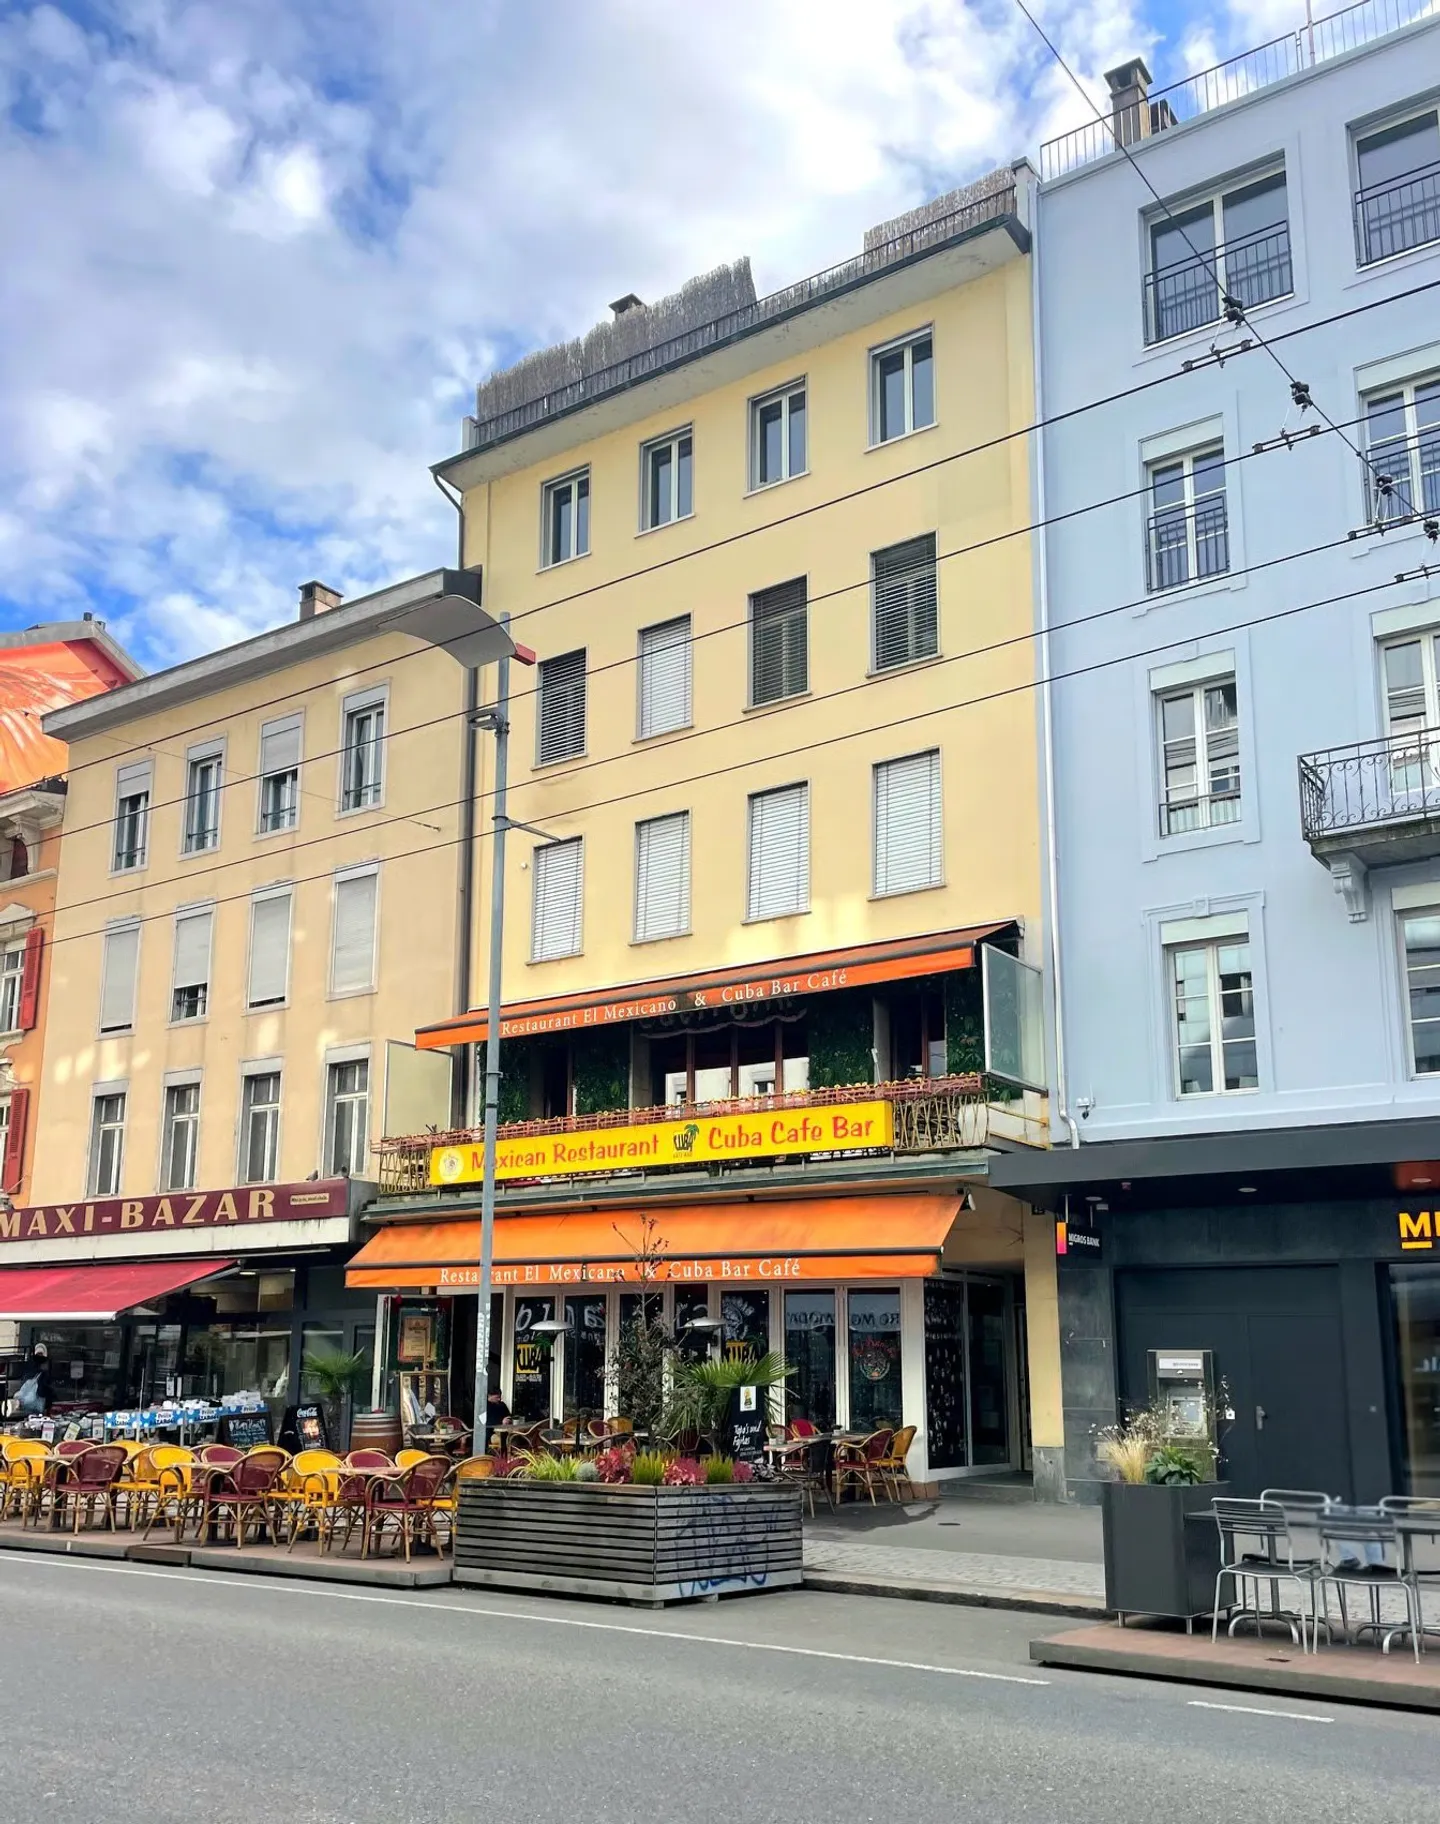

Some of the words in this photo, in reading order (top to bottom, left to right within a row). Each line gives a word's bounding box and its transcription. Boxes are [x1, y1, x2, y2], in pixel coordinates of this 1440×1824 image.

[502, 1014, 577, 1035] Restaurant
[583, 1009, 597, 1024] El
[604, 999, 677, 1020] Mexicano
[694, 991, 707, 1007] &
[722, 984, 765, 1002] Cuba
[771, 979, 800, 996] Bar
[807, 968, 847, 989] Café
[552, 1134, 659, 1164] Restaurant
[708, 1124, 762, 1150] Cuba
[770, 1117, 823, 1145] Cafe
[832, 1116, 874, 1139] Bar
[0, 1189, 275, 1238] MAXI-BAZAR
[1068, 1232, 1087, 1245] MIGROS
[1087, 1236, 1100, 1248] BANK
[525, 1265, 539, 1281] El
[669, 1261, 713, 1279] Cuba
[721, 1260, 750, 1277] Bar
[758, 1258, 801, 1276] Café
